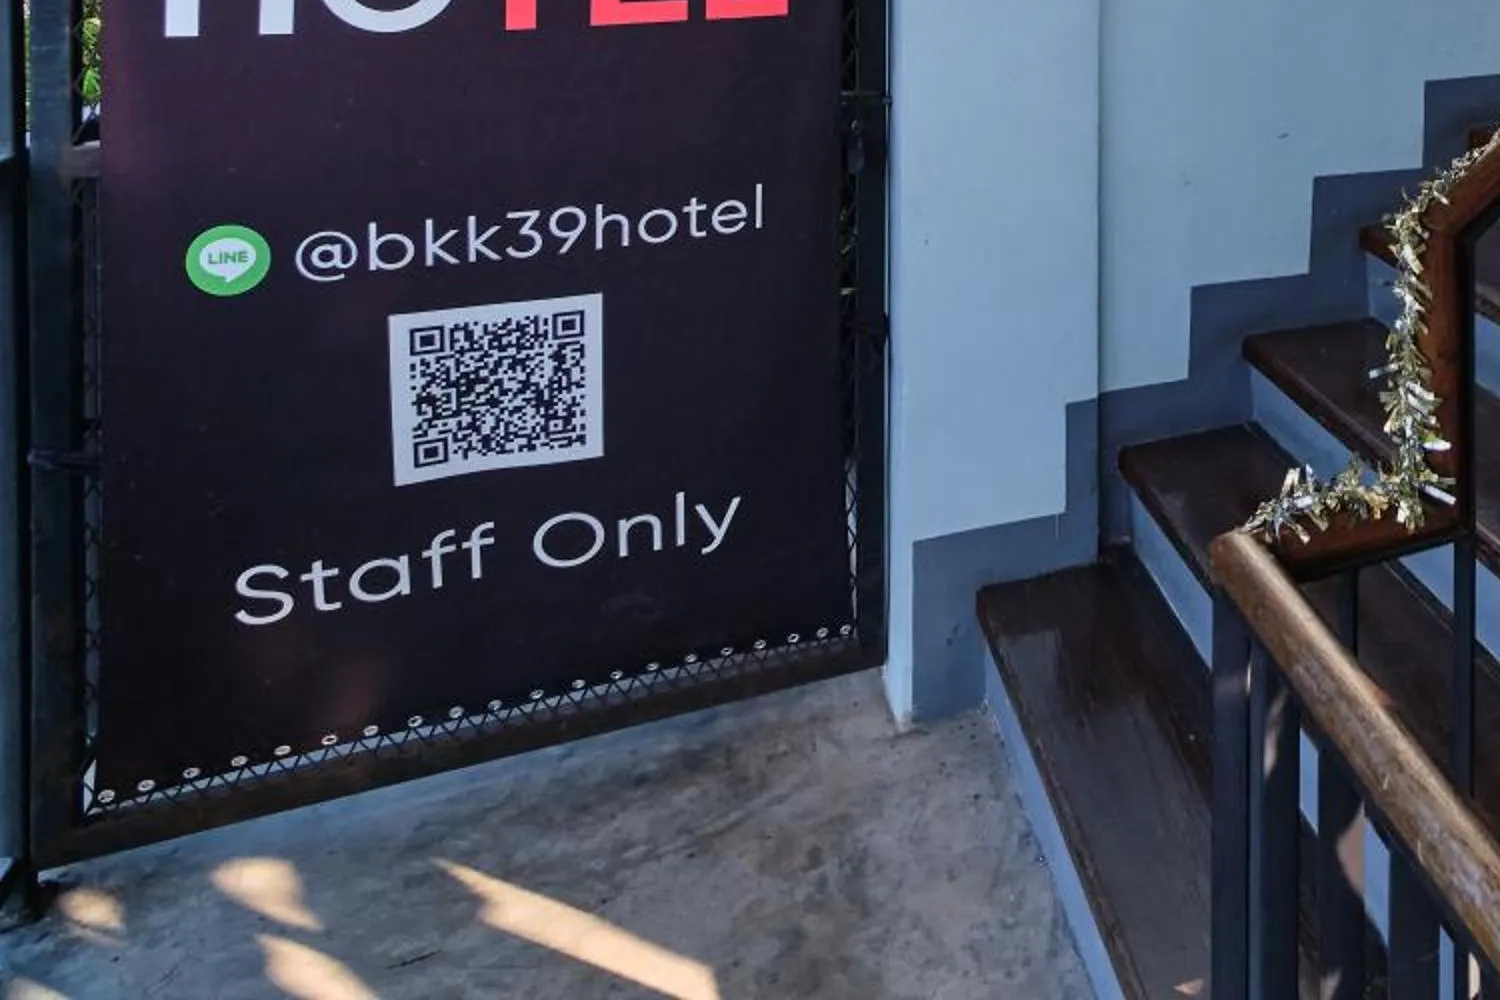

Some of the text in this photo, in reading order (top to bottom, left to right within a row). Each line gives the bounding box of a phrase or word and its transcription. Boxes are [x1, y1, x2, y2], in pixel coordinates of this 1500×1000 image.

[207, 250, 249, 265] LINE
[295, 183, 765, 282] @bkk39hotel
[234, 490, 742, 626] Staff Only
